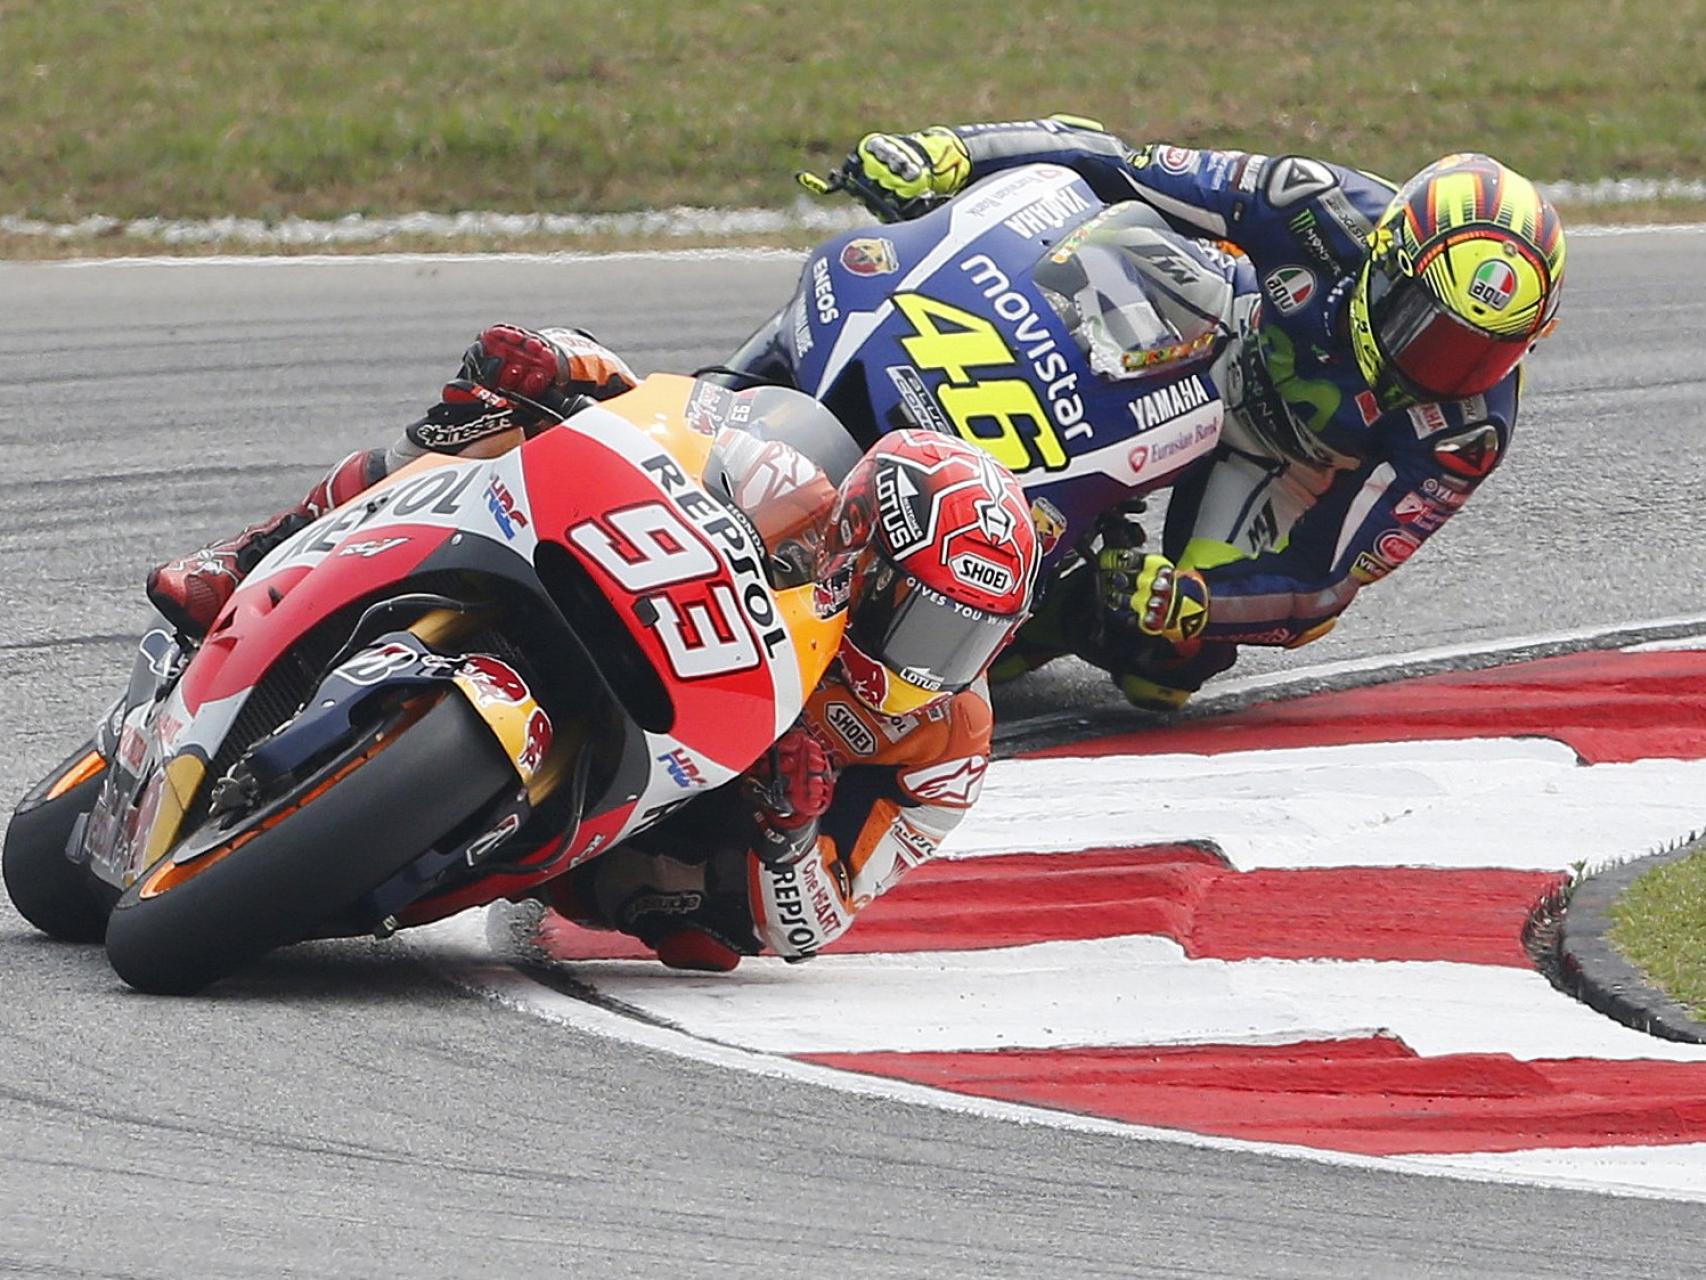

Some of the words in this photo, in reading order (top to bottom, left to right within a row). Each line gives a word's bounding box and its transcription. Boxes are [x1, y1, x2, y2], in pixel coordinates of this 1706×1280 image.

[1003, 185, 1091, 240] YAMAHA
[812, 256, 839, 325] ENEOS
[1266, 279, 1294, 310] agv
[1472, 280, 1504, 307] agv
[960, 254, 1094, 441] movistar
[893, 288, 1070, 472] 46
[1127, 374, 1210, 431] YAMAHA
[726, 503, 766, 559] HONDA
[875, 467, 912, 549] LOTUS
[641, 453, 787, 660] REPSOL
[958, 557, 1007, 590] SHOEI
[566, 500, 761, 681] 93
[906, 576, 947, 606] GIVES
[954, 602, 983, 621] YOU
[899, 668, 942, 692] LOTUS
[829, 704, 872, 752] SHOEI
[802, 859, 818, 893] One
